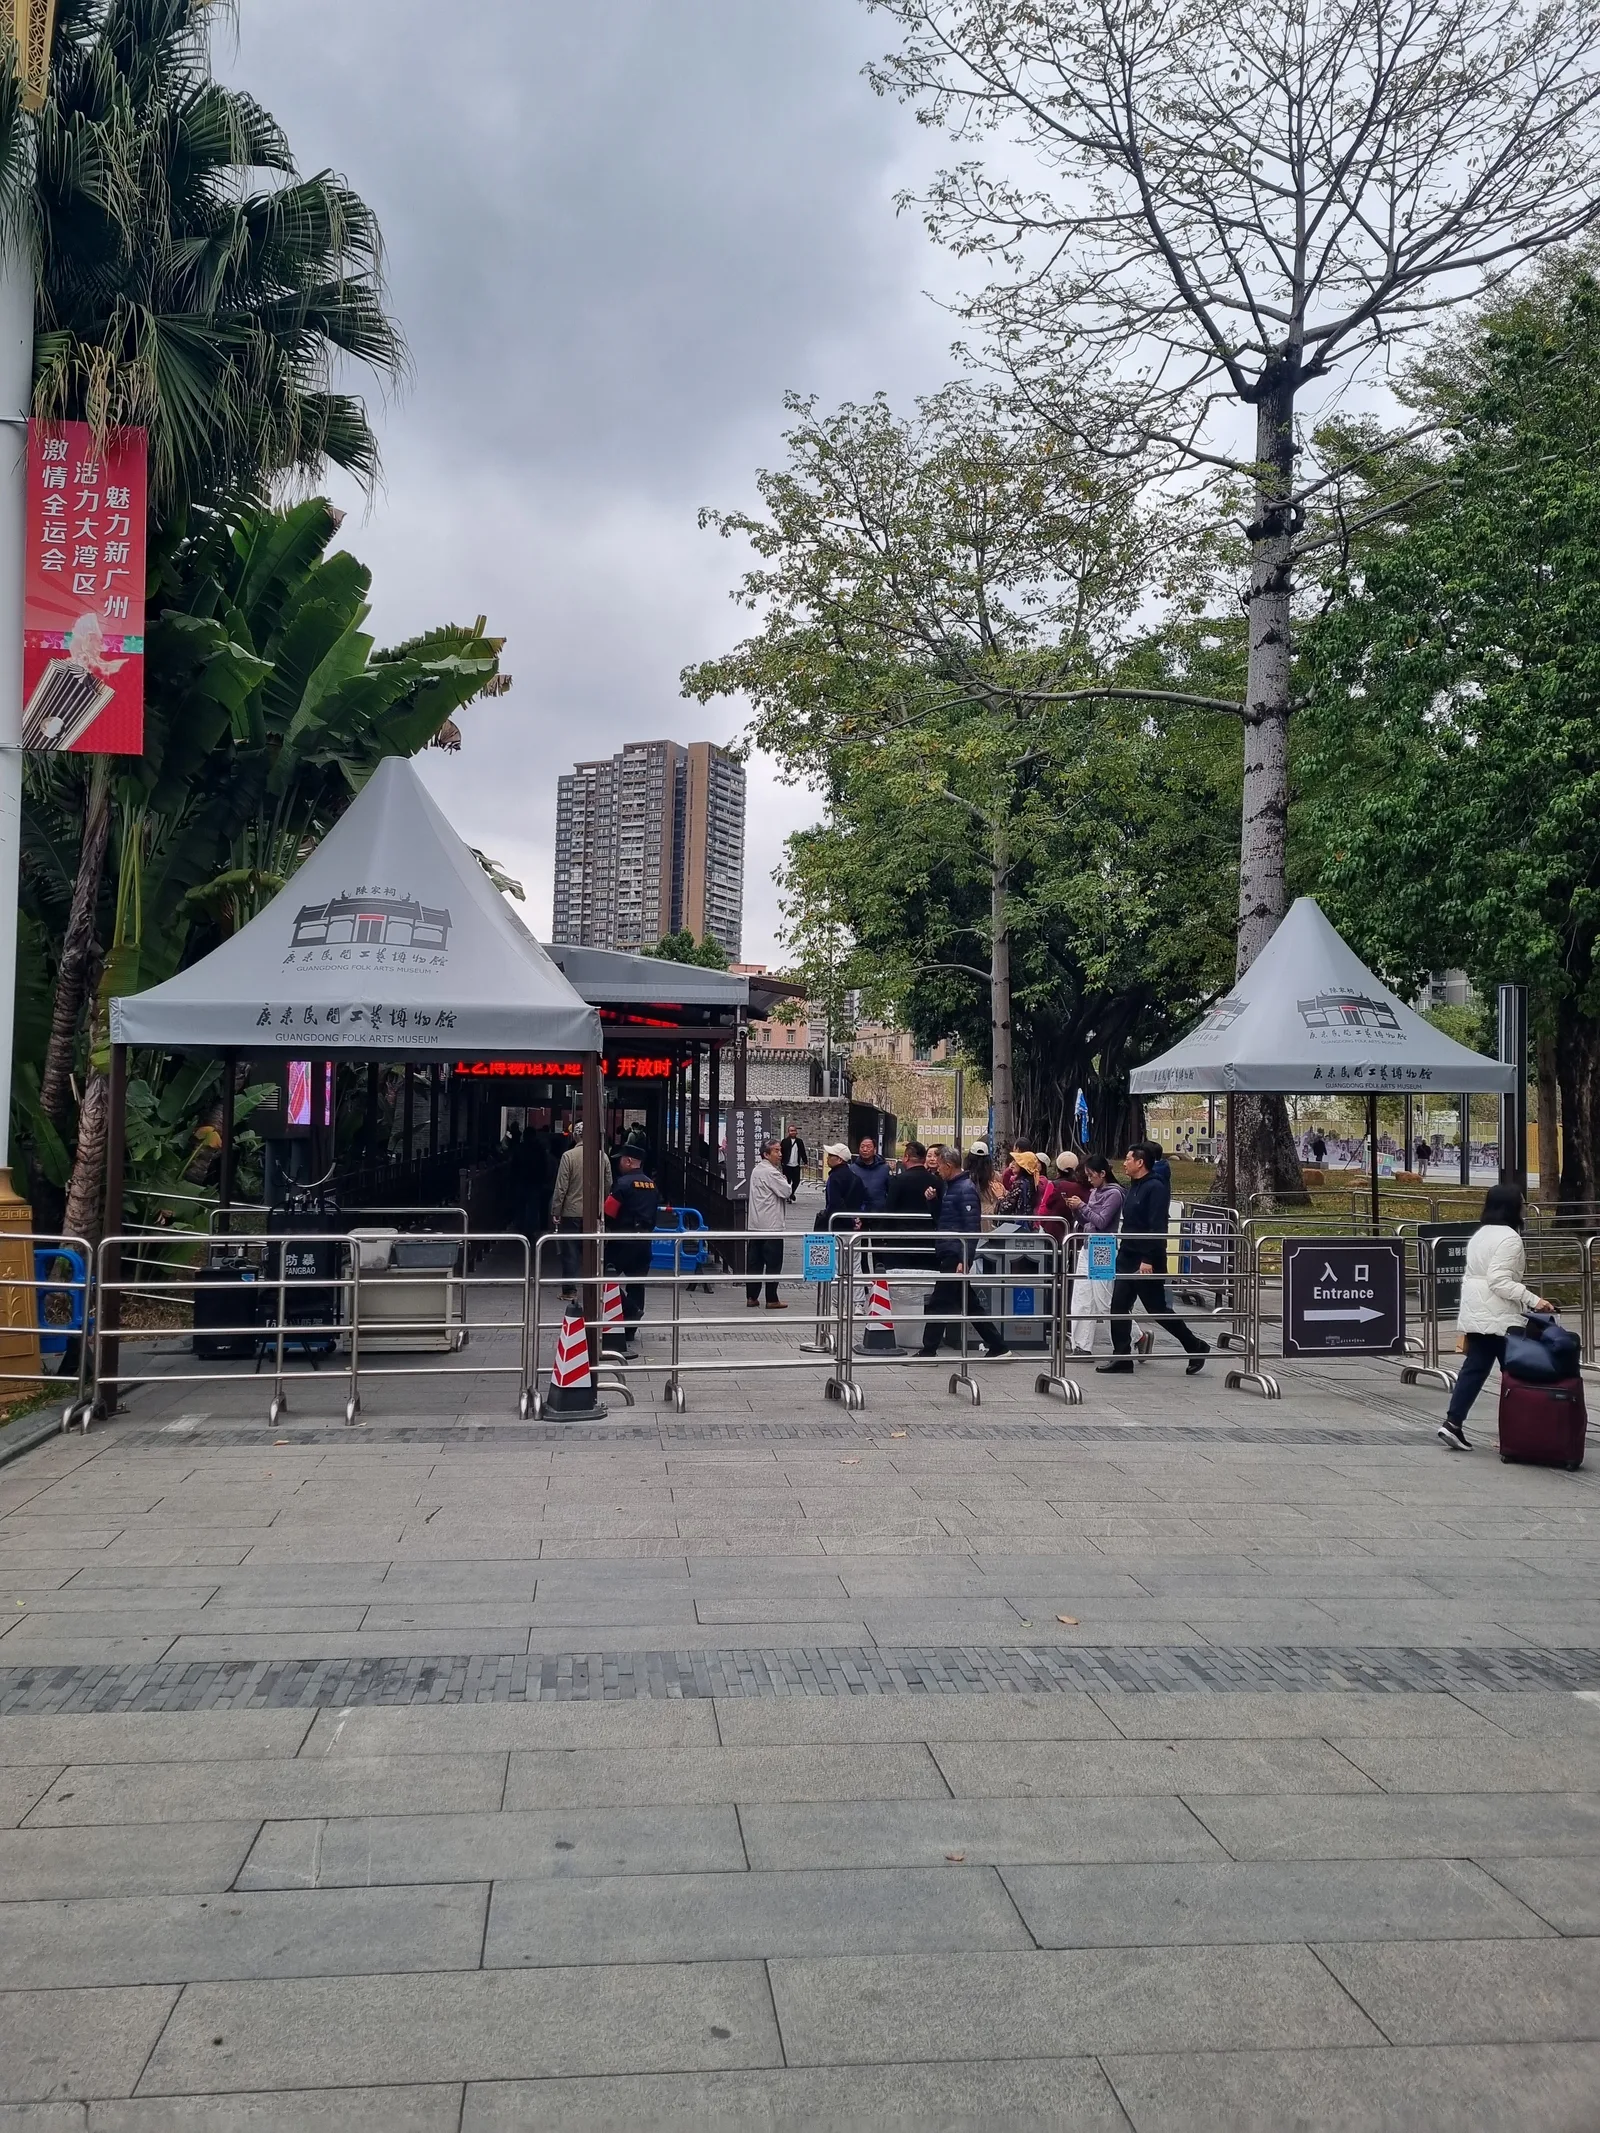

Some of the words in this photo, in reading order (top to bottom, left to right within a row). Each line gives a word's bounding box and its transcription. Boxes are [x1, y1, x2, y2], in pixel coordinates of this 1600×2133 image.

[40, 438, 69, 573] 激情全运会
[72, 460, 99, 596] 活力大湾区
[102, 485, 131, 620] 魅力新广州
[296, 964, 349, 972] GUANGDONG
[396, 967, 432, 975] MUSEUM
[275, 1033, 339, 1042] GUANGDONG
[342, 1034, 366, 1042] FOLK
[369, 1034, 394, 1043] ARTS
[397, 1035, 438, 1044] MUSEUM
[1325, 1082, 1365, 1090] GUANGDONG
[1320, 1262, 1369, 1282] 入口
[1313, 1286, 1374, 1300] Entrance
